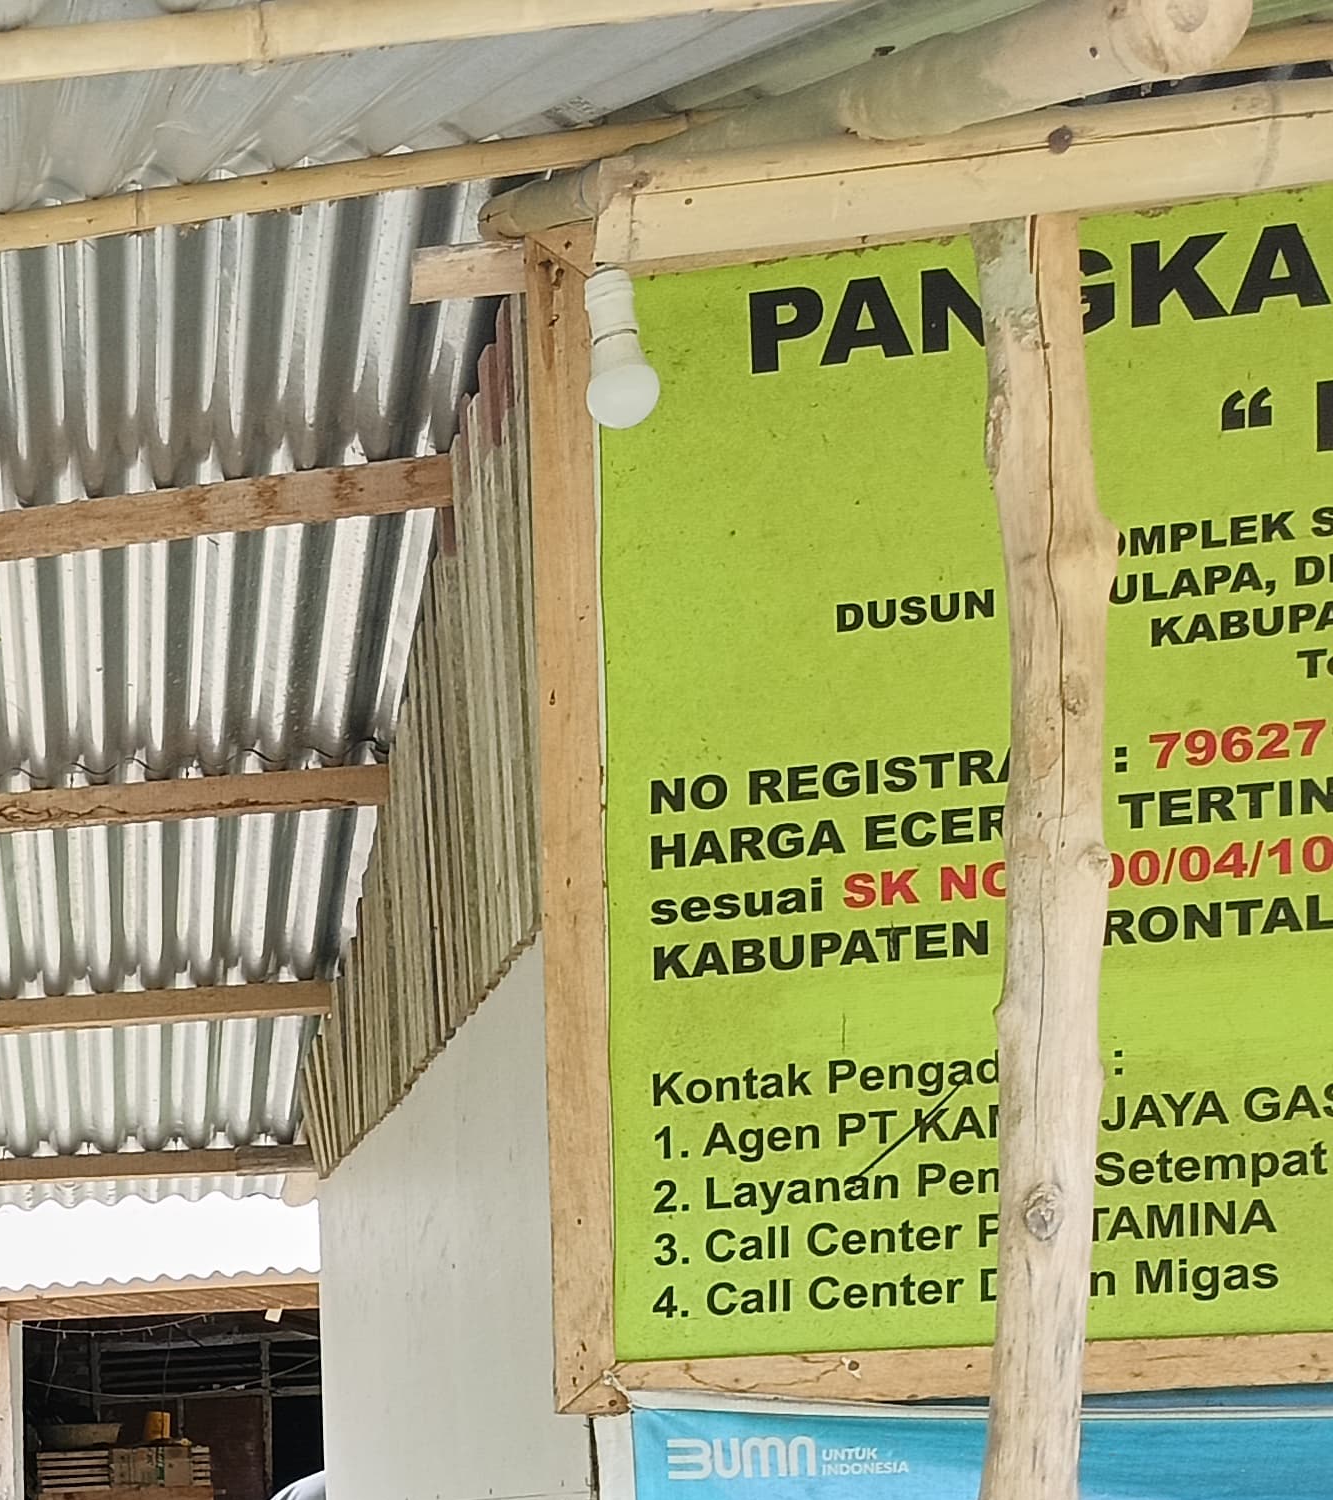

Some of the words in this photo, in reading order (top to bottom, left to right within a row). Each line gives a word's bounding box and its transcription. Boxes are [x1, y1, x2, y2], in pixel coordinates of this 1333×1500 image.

[1118, 511, 1295, 558] MPLEK
[835, 589, 995, 633] DUSUN
[1295, 555, 1333, 586] D
[1151, 600, 1333, 647] KABUPA
[1297, 648, 1333, 678] T
[650, 774, 728, 815] NO
[1149, 719, 1327, 770] 79627
[650, 820, 845, 870] HARGA
[1118, 776, 1333, 829] TERTIN
[651, 877, 823, 925] sesuai
[843, 868, 920, 909] SK
[652, 920, 989, 981] KABUPATEN
[652, 1063, 812, 1107] Kontak
[653, 1126, 690, 1160] 1.
[702, 1122, 820, 1163] Agen
[838, 1110, 897, 1147] PT
[914, 1104, 998, 1143] KA
[1101, 1090, 1229, 1131] JAYA
[652, 1180, 690, 1213] 2.
[705, 1172, 899, 1216] Layanan
[1094, 1141, 1328, 1187] Setempat
[653, 1233, 690, 1265] 3.
[705, 1225, 789, 1262] Call
[807, 1220, 962, 1256] Center
[652, 1286, 689, 1318] 4.
[706, 1279, 791, 1315] Call
[808, 1274, 964, 1310] Center
[1135, 1258, 1279, 1301] Migas
[822, 1447, 878, 1462] UNTUK
[822, 1461, 910, 1476] INDONESIA
